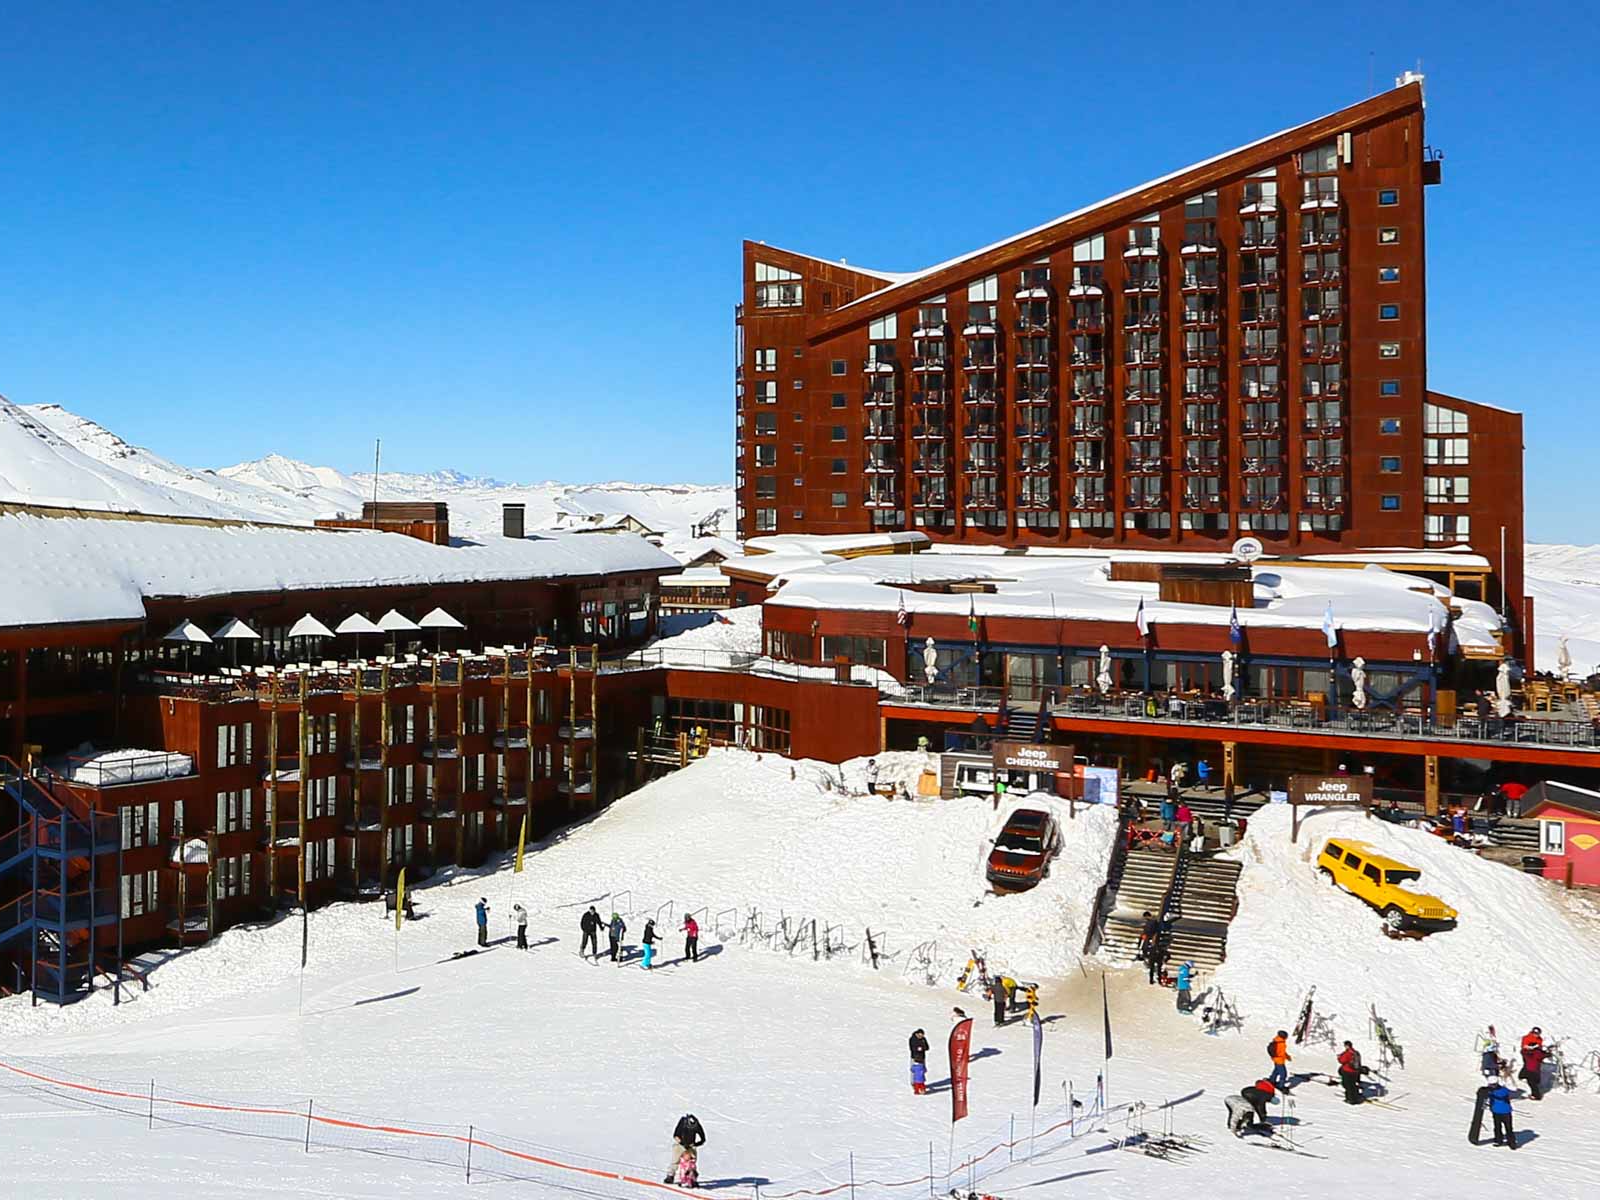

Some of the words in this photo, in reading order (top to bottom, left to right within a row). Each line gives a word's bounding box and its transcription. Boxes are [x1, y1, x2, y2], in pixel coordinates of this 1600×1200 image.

[1018, 748, 1047, 758] Jeep
[1006, 758, 1060, 768] CHEROKEE
[1318, 782, 1347, 792] Jeep
[1304, 793, 1360, 801] WRANGLER
